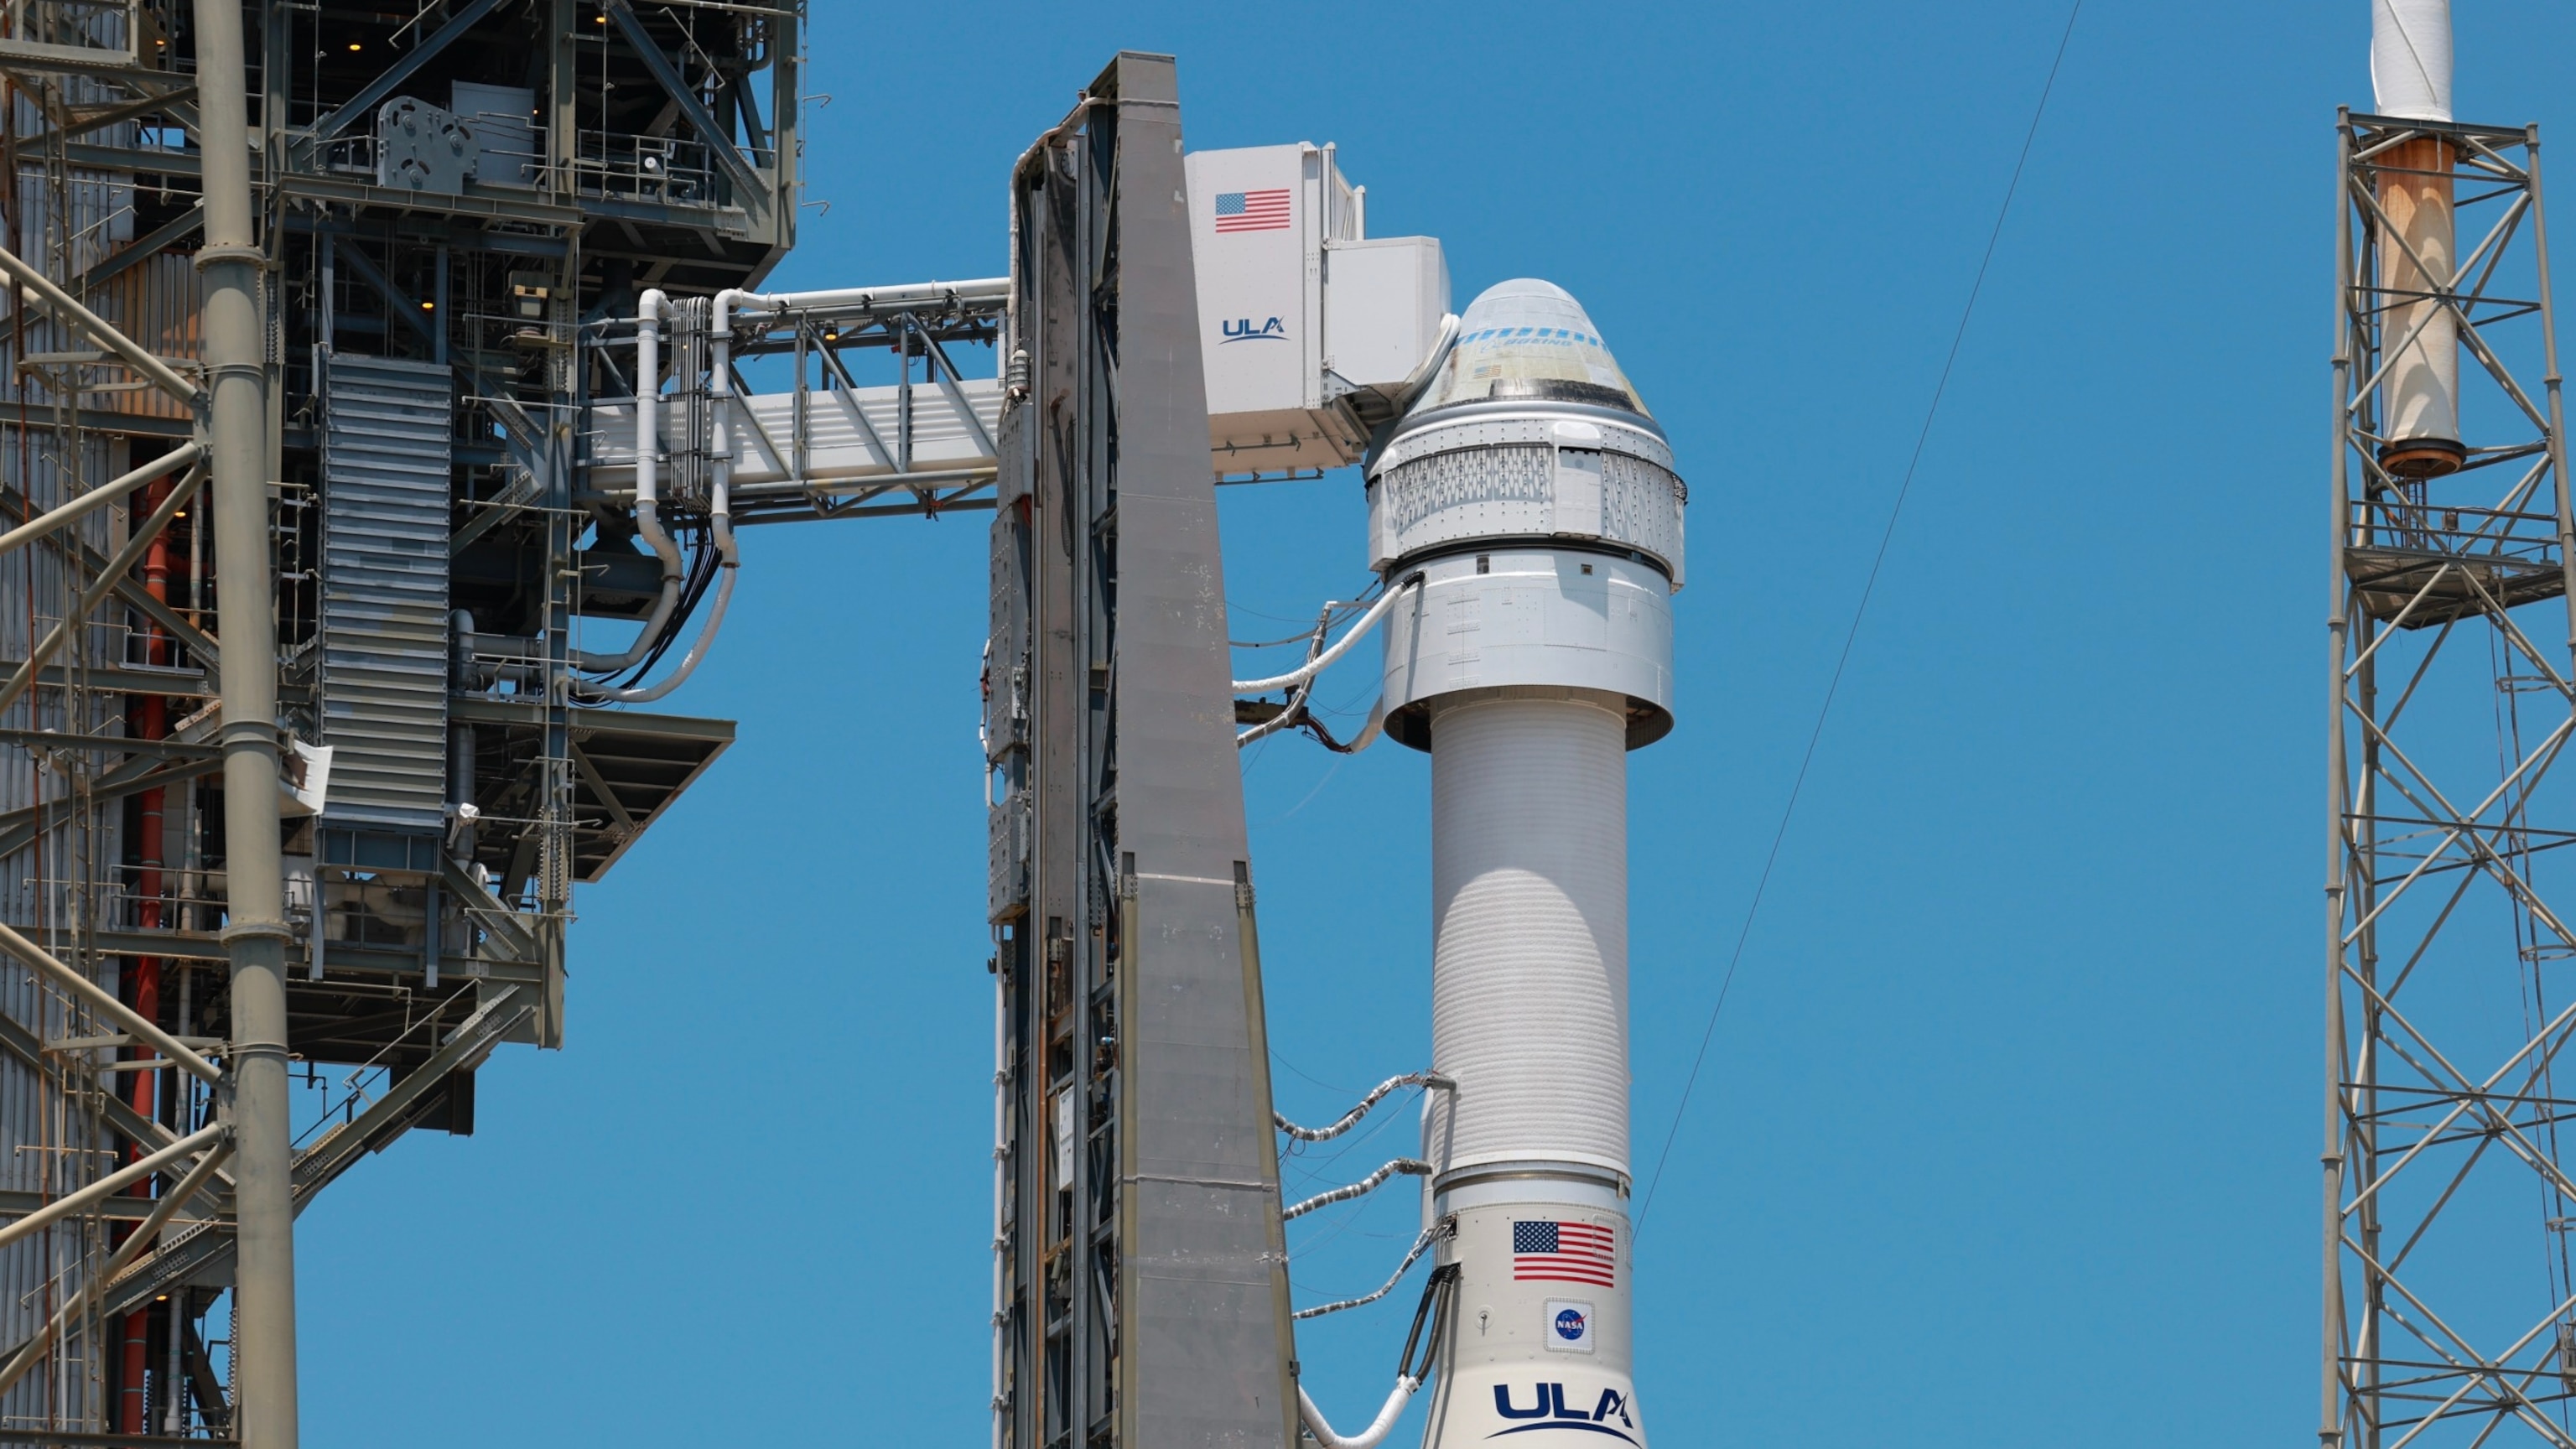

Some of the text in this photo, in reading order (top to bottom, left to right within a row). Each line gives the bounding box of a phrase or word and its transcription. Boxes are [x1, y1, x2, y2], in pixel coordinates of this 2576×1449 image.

[1223, 315, 1285, 336] ULA
[1504, 338, 1572, 346] BOEING
[1557, 1321, 1583, 1330] NASA
[1493, 1383, 1634, 1430] ULA
